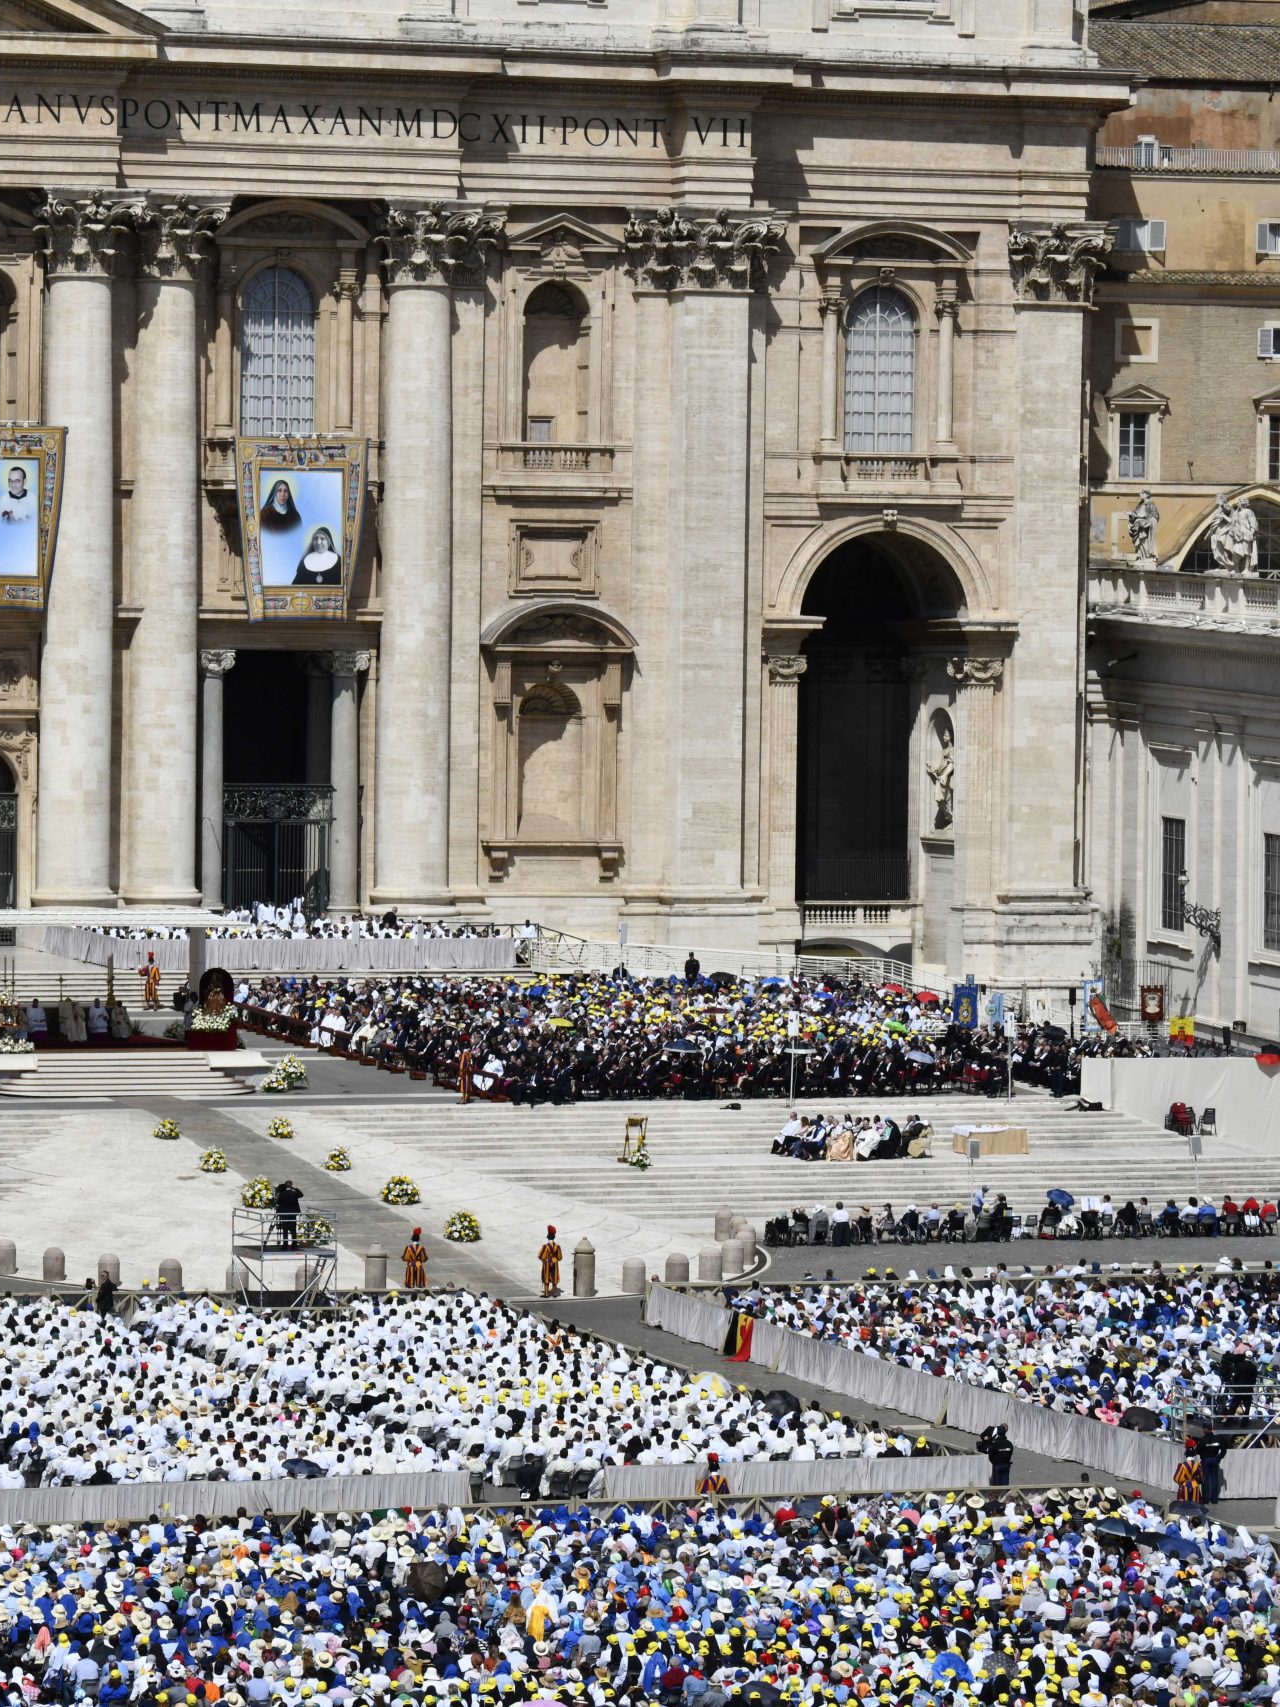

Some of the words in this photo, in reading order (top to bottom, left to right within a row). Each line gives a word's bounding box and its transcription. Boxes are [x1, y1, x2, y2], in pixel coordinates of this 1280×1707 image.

[117, 97, 229, 131] PONT
[232, 102, 320, 136] MAX
[326, 105, 383, 137] AN
[393, 107, 546, 145] MDCXII
[560, 115, 665, 148] PONT
[690, 117, 748, 149] VII
